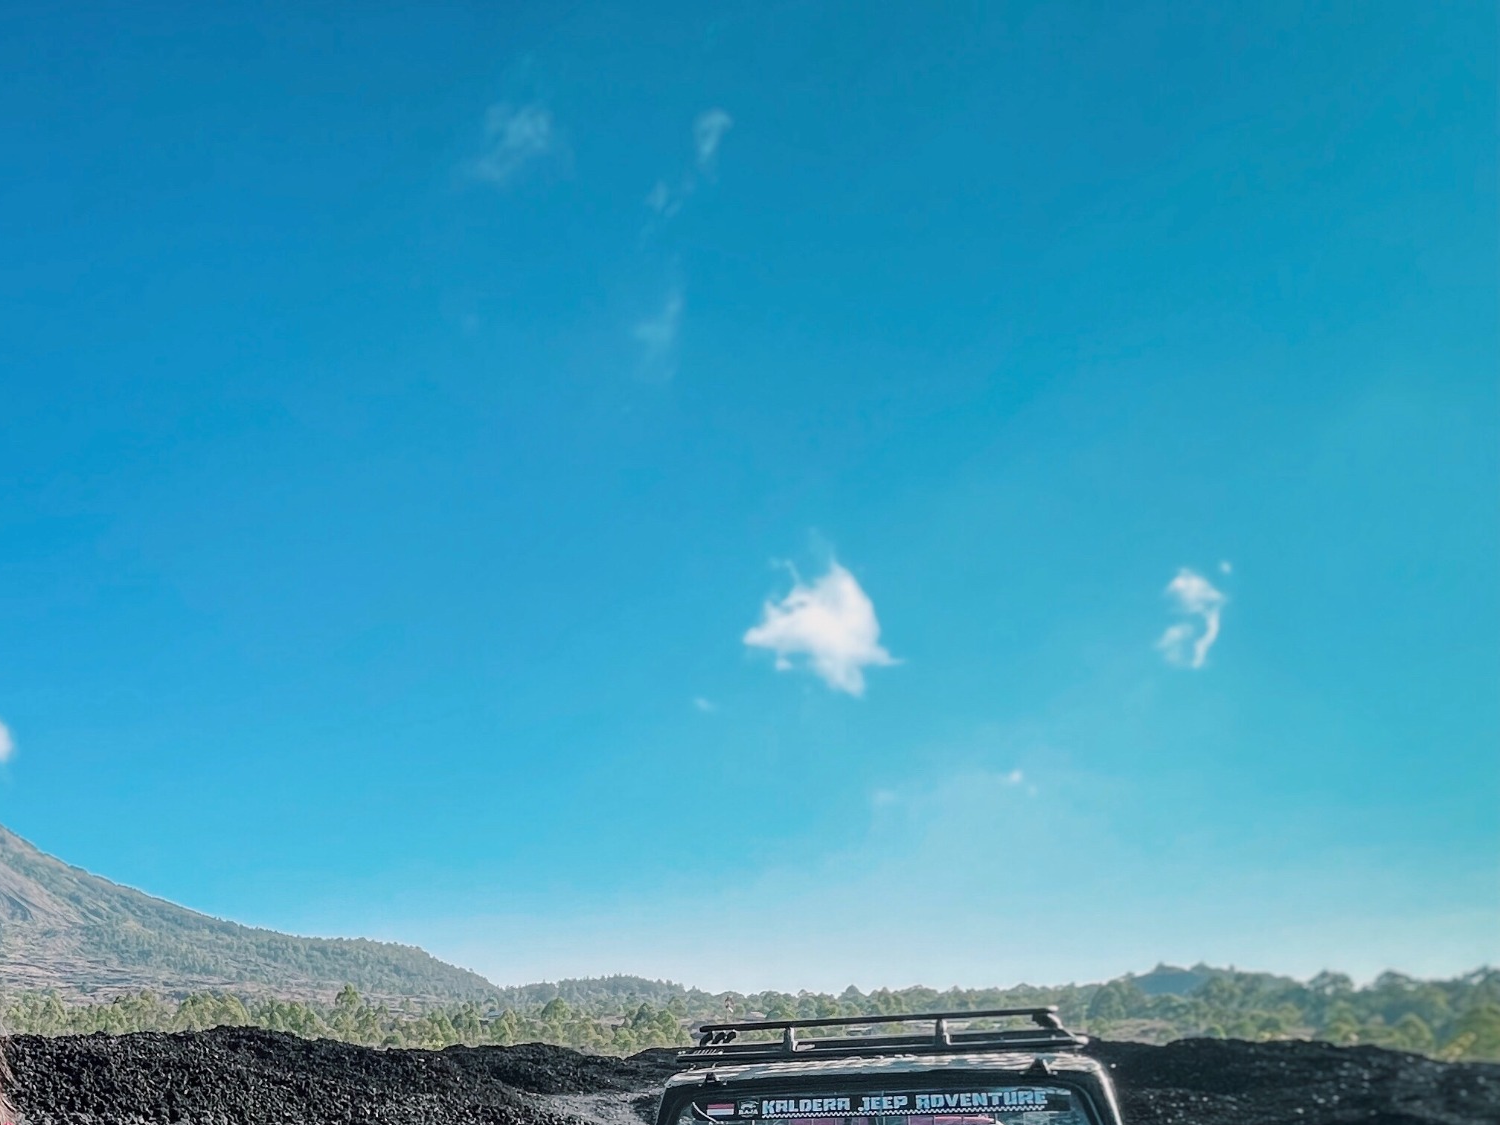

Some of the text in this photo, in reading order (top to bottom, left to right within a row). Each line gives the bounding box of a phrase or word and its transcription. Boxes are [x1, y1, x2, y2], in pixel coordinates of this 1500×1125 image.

[761, 1091, 1048, 1114] KALDERA JEEP ADVENTURE
